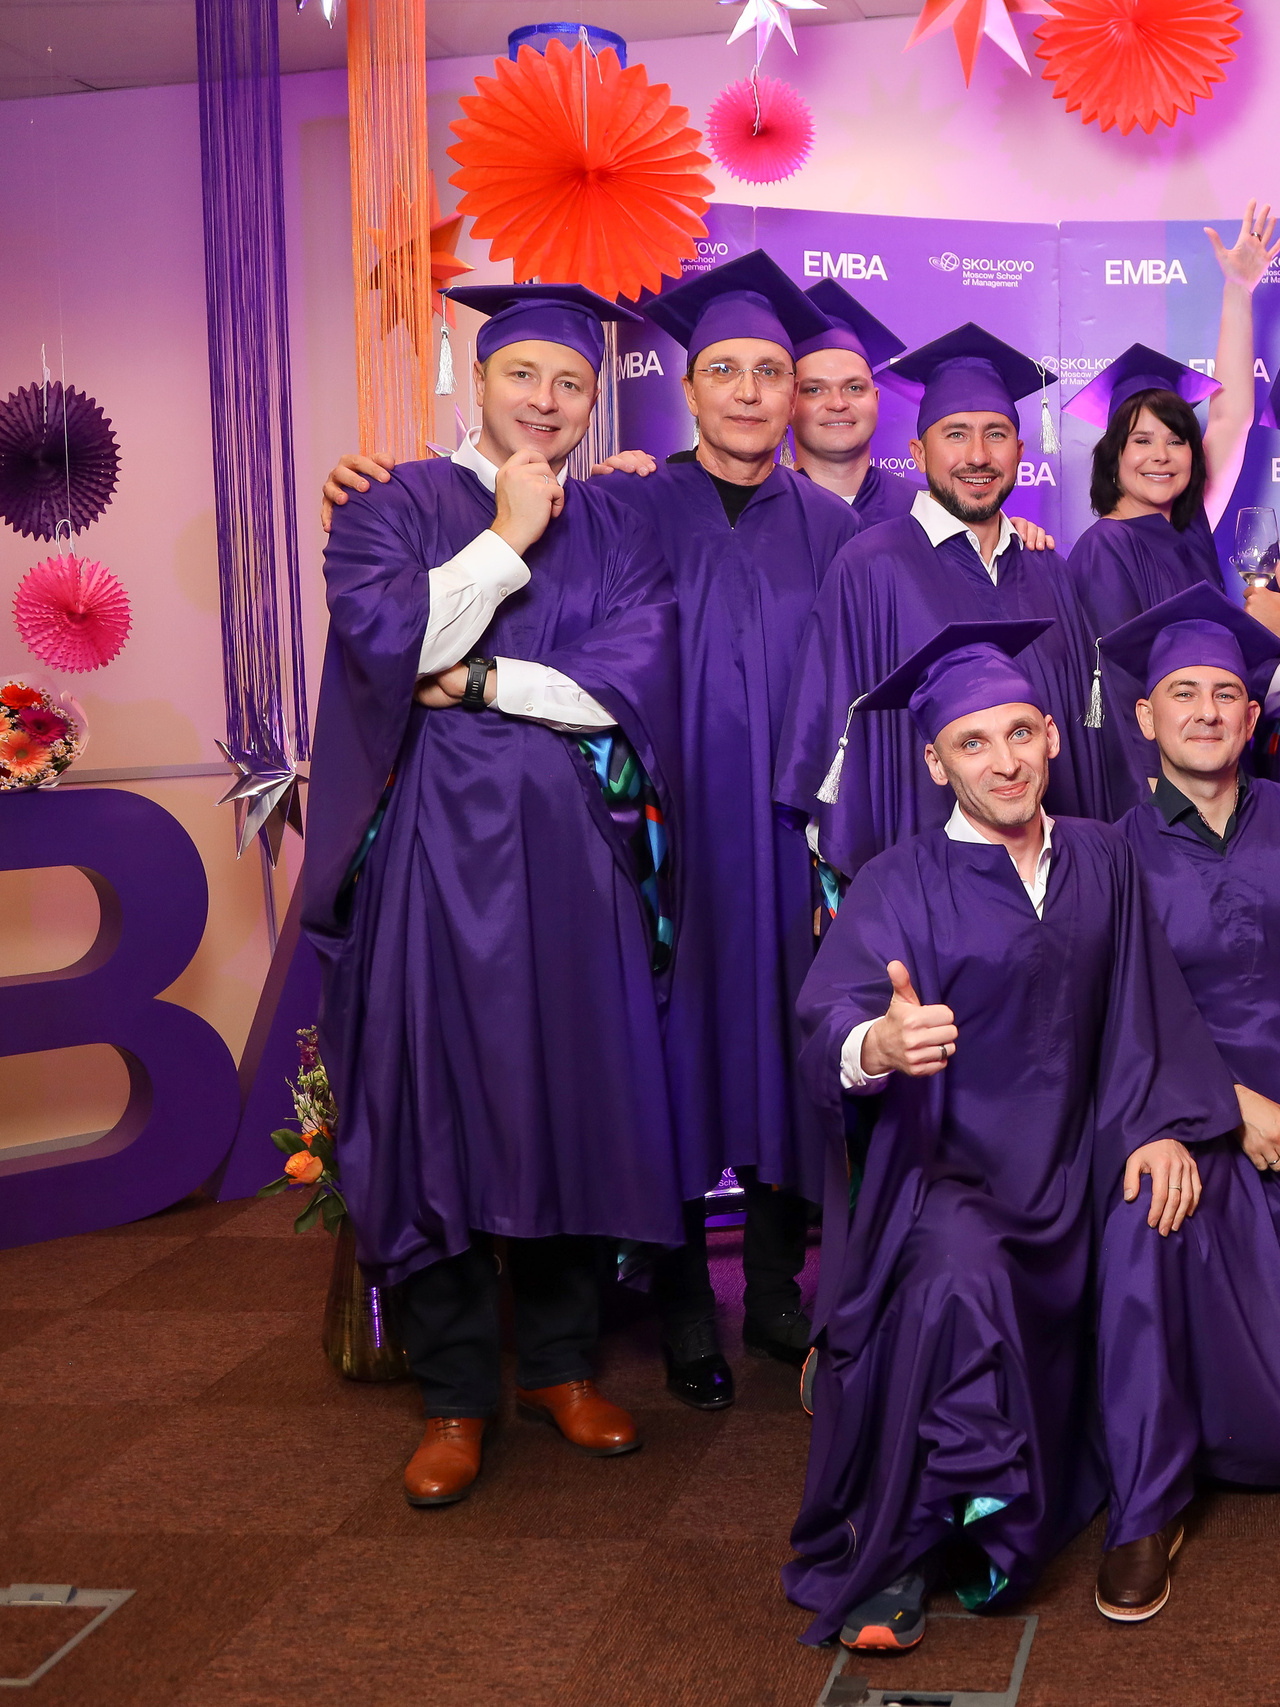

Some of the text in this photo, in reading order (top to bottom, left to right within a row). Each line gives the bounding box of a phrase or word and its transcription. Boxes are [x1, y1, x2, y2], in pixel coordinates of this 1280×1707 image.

[803, 250, 889, 281] EMBA
[962, 258, 1035, 273] SKOLKOVO
[1105, 259, 1188, 285] EMBA
[962, 271, 1023, 281] Moscow School
[971, 279, 1019, 288] Management
[1261, 276, 1269, 284] of
[617, 350, 665, 381] MBA
[1060, 358, 1116, 370] SKOLKO
[1016, 461, 1057, 487] BA
